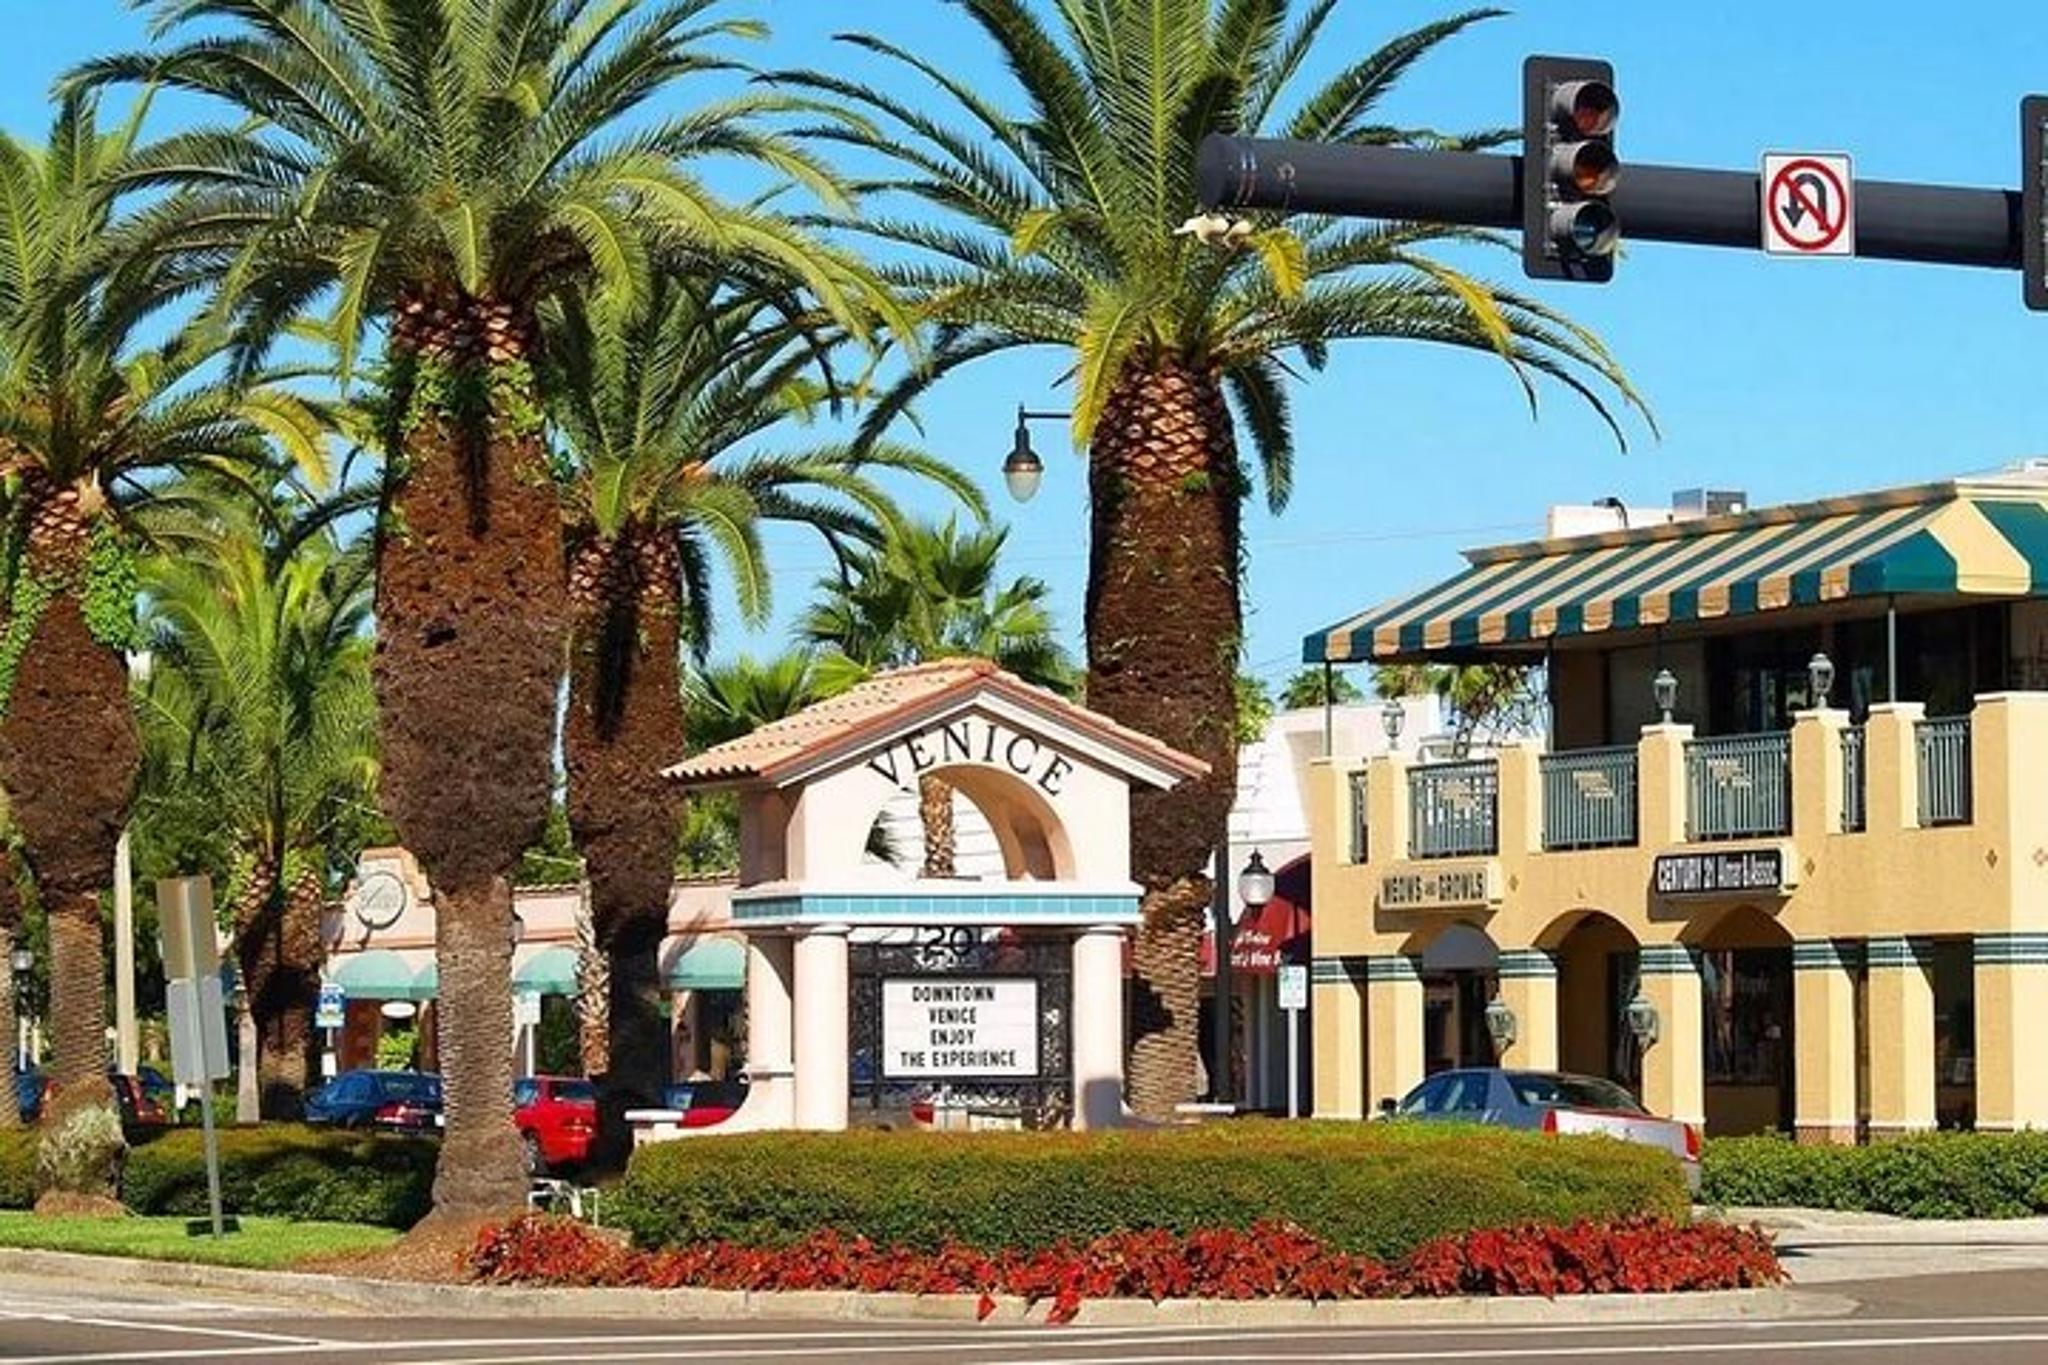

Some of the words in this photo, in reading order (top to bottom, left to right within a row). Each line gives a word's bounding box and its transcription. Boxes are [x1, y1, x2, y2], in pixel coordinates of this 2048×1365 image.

[866, 722, 1073, 797] VENICE
[912, 986, 996, 1002] DOWNTOWN
[928, 1007, 977, 1024] VENICE
[930, 1029, 976, 1046] ENJOY
[900, 1051, 925, 1067] THE
[932, 1050, 1016, 1068] EXPERIENCE
